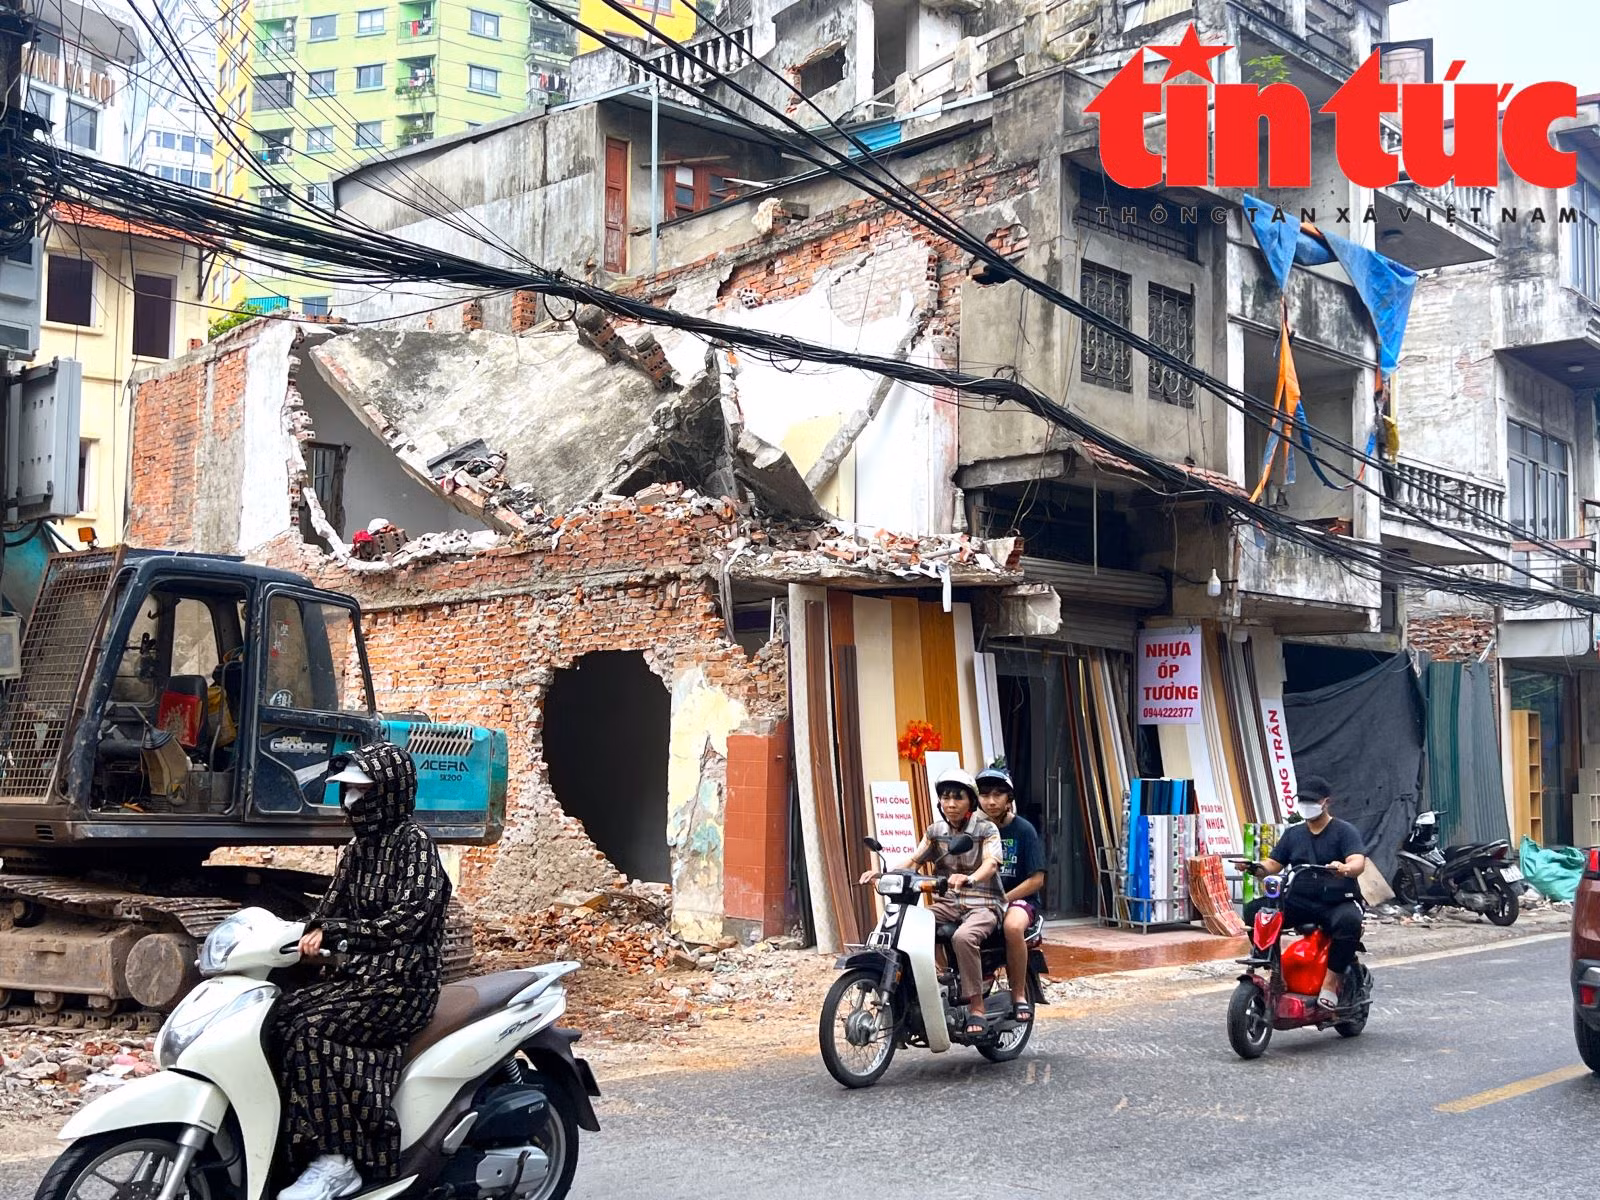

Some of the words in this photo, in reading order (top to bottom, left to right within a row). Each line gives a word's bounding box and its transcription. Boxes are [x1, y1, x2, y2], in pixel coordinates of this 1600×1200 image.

[1145, 641, 1191, 660] NHỰA
[1158, 660, 1180, 679] ỐP
[1143, 707, 1194, 718] 0944222377
[419, 759, 470, 772] ACERA
[875, 796, 888, 804] THI
[889, 794, 910, 805] CÔNG
